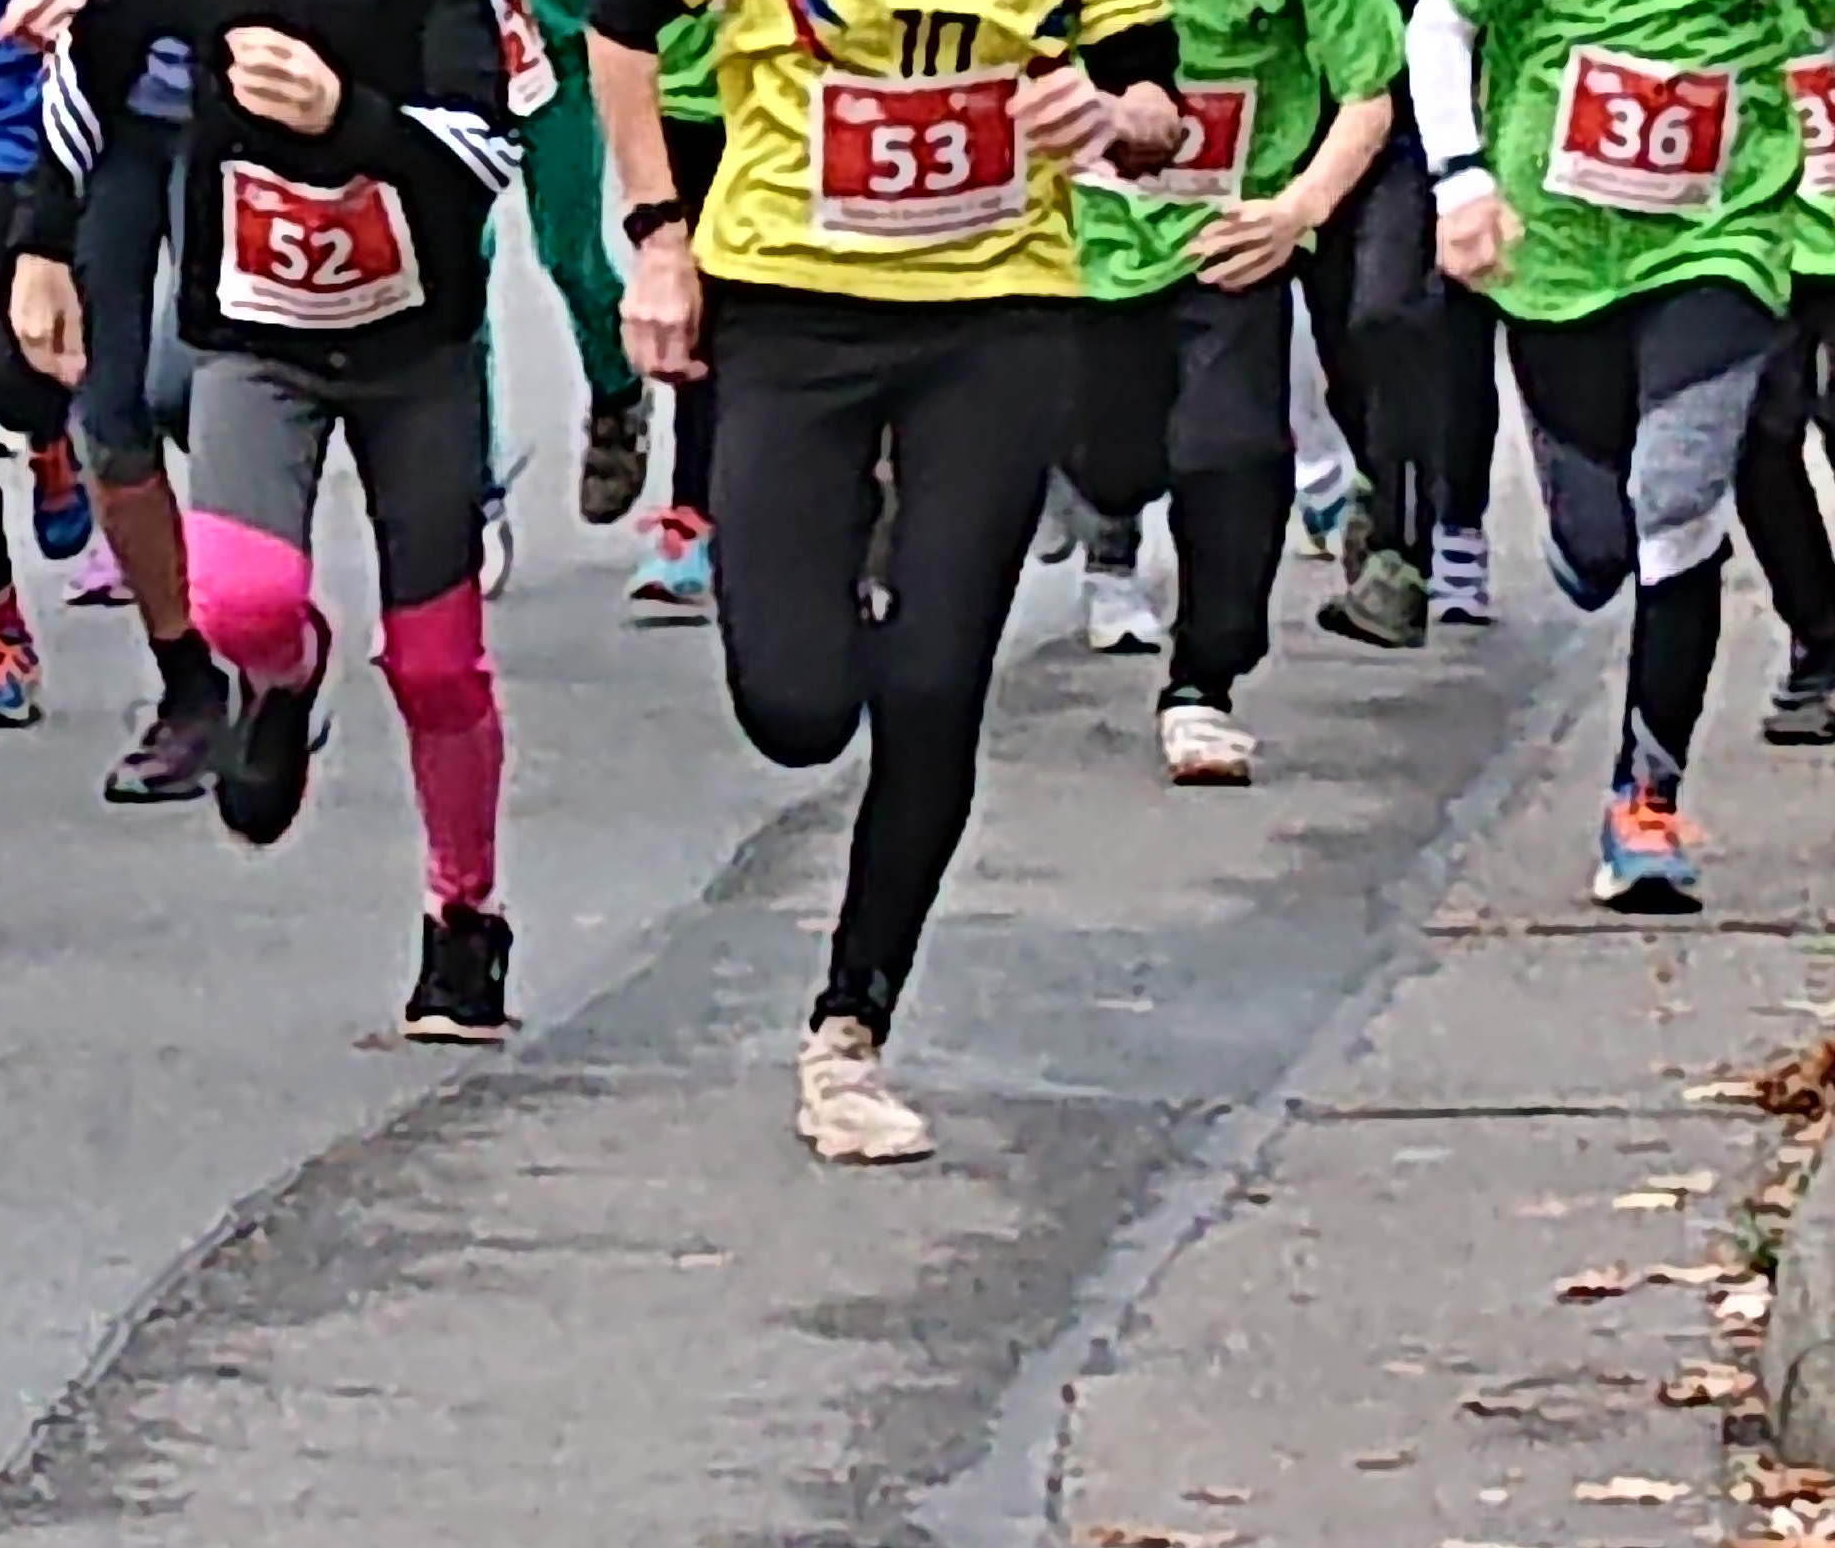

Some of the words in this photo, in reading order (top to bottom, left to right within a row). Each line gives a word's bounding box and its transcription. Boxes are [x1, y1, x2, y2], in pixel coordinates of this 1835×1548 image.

[869, 121, 970, 193] 53
[1599, 97, 1691, 166] 36
[269, 217, 358, 285] 52
